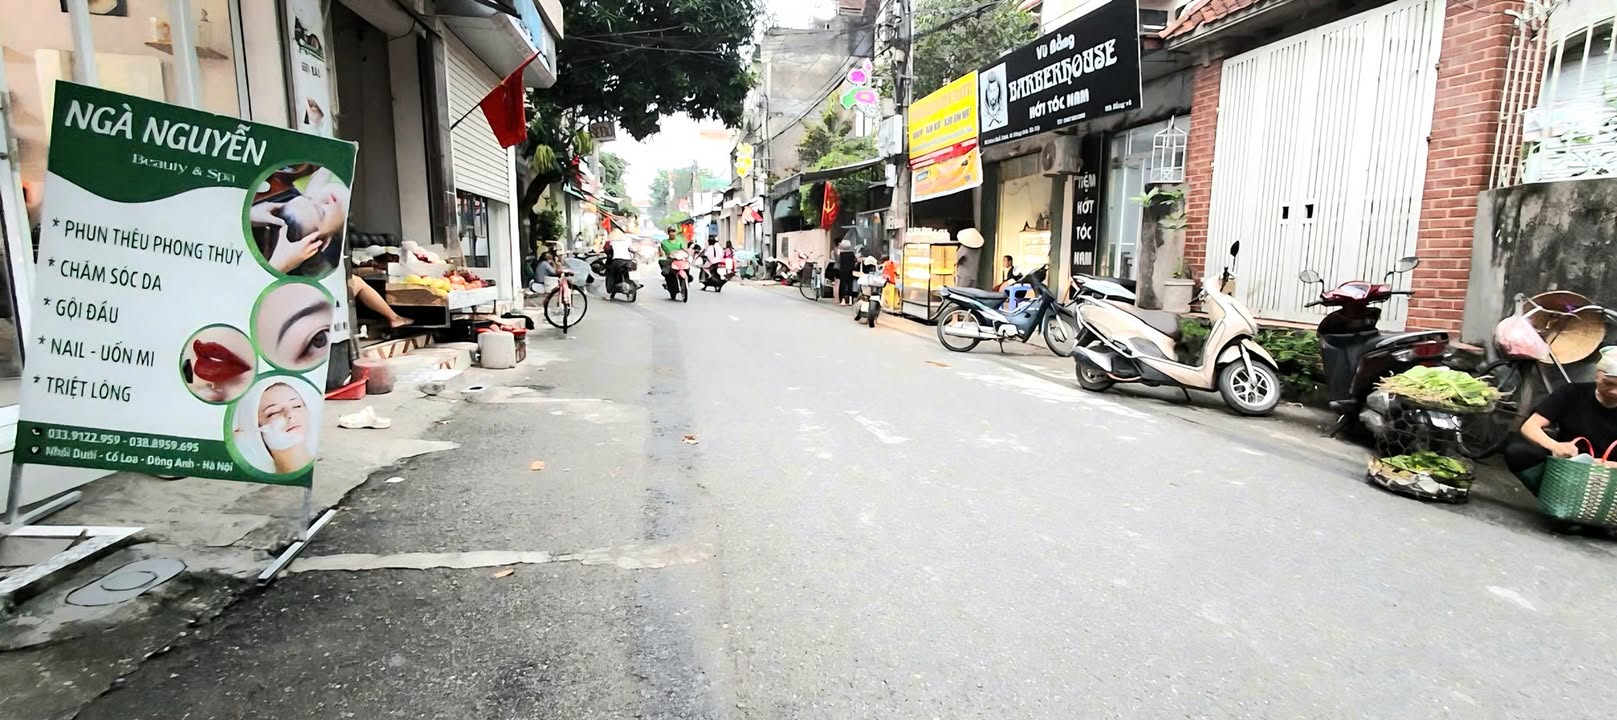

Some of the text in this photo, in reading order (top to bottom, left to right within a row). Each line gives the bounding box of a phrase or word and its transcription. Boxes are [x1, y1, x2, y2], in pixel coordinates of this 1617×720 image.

[1029, 100, 1046, 119] HỚT
[1047, 95, 1065, 113] TÓC
[1066, 88, 1090, 107] NAM
[64, 99, 267, 166] NGÀ NGUYỄN
[132, 153, 236, 183] Beauty & Spa
[1076, 198, 1094, 215] HỚT
[64, 219, 108, 244] PHUN
[113, 228, 149, 250] THÊU
[153, 235, 203, 260] PHONG
[1076, 222, 1092, 240] TÓC
[1073, 251, 1092, 265] NAM
[60, 259, 162, 291] CHĂM SÓC DA
[56, 296, 83, 321] GỘI
[50, 338, 85, 358] NAIL
[101, 340, 133, 364] UỐN
[135, 349, 155, 367] MI
[46, 376, 132, 402] TRIỆT LÔNG
